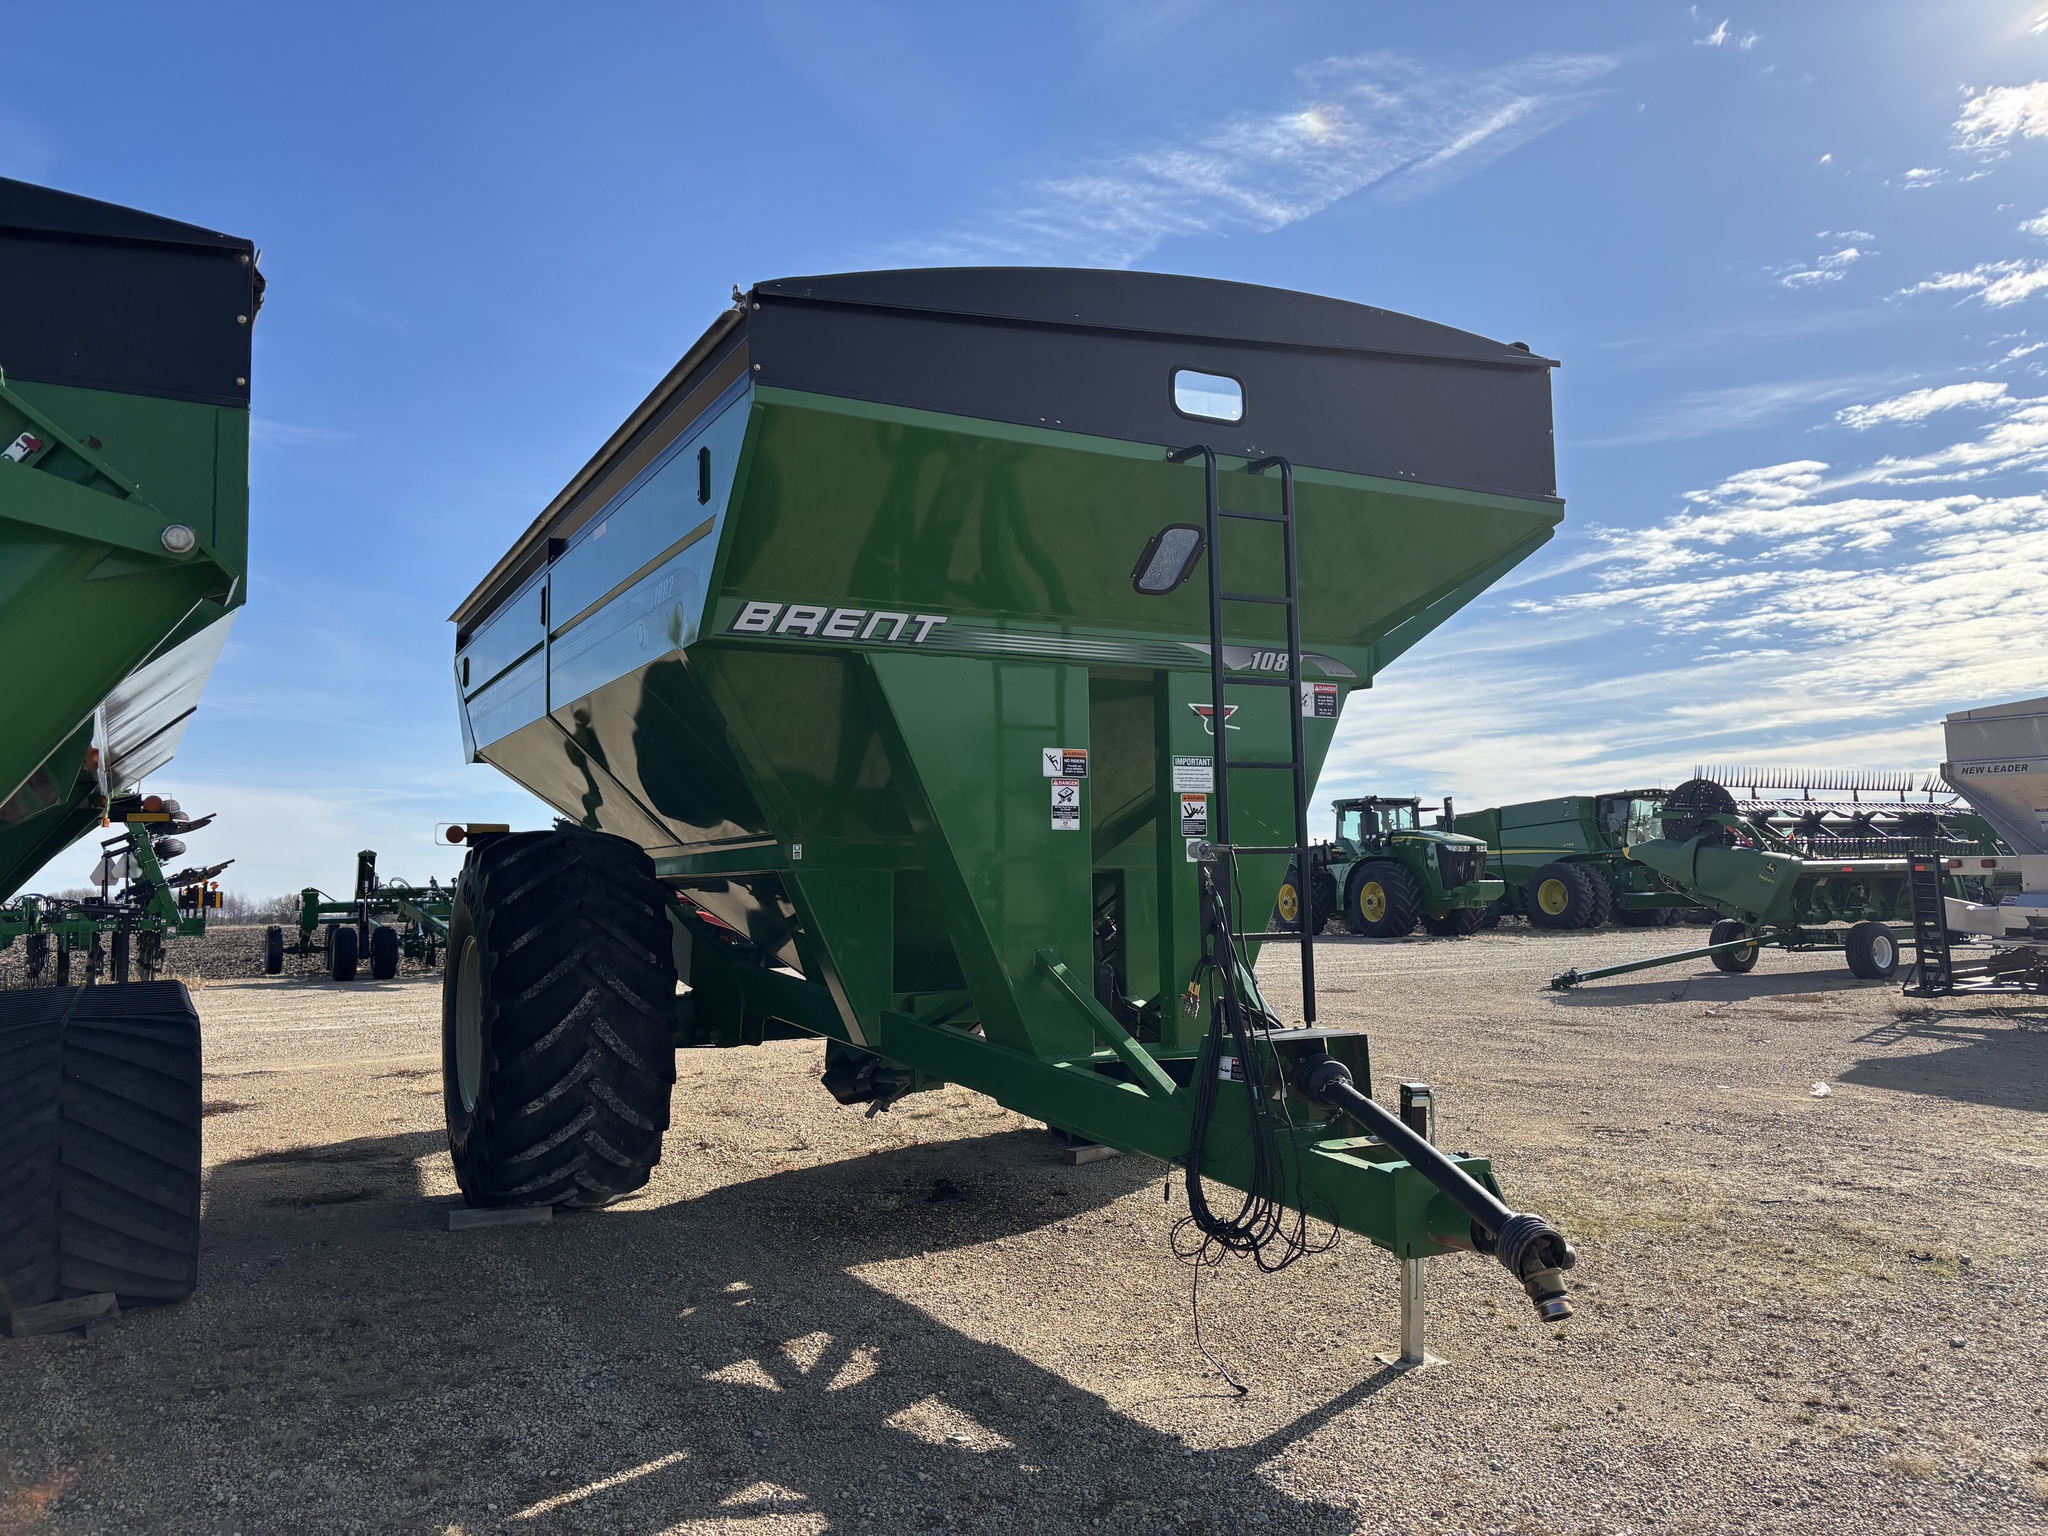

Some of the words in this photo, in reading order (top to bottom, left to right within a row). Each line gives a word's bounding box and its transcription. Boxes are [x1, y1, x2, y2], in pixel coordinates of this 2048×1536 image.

[653, 573, 676, 607] 1082
[728, 600, 948, 645] BRENT
[1250, 651, 1304, 673] 108
[1174, 757, 1211, 766] IMPORTANT
[1961, 766, 1985, 775] NEW
[1987, 764, 2029, 773] LEADER
